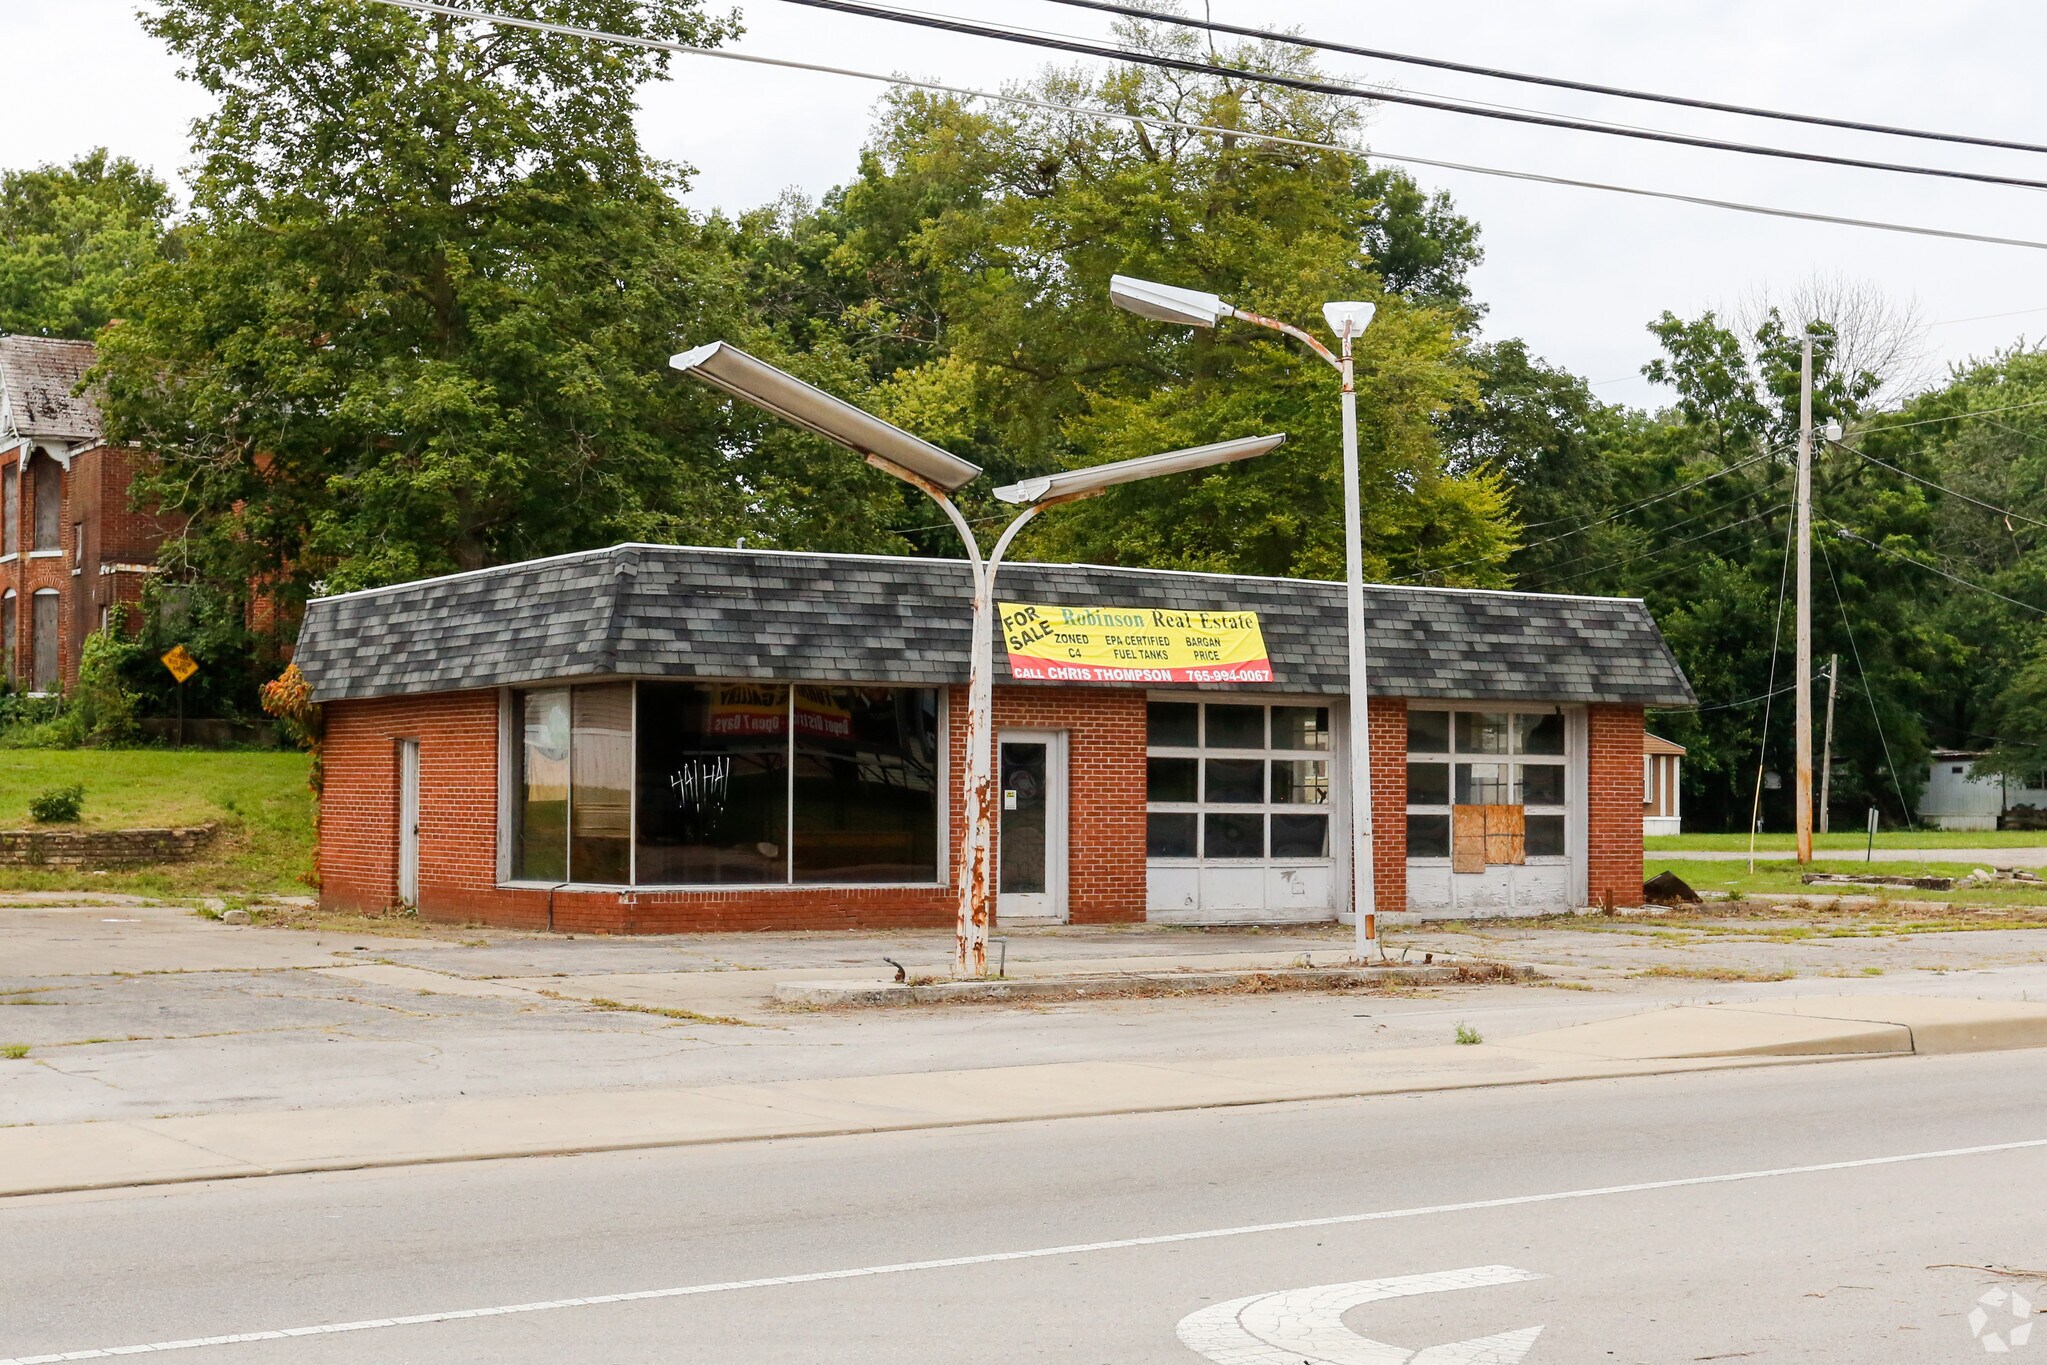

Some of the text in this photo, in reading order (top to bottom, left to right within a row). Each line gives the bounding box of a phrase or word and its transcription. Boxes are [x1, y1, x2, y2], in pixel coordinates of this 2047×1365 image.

[1003, 606, 1040, 632] FOR
[1060, 608, 1254, 629] Robinson Real Estate
[1009, 620, 1054, 650] SALE
[1055, 633, 1089, 644] ZONED
[1105, 635, 1170, 646] EPA CERTIFIED
[1185, 636, 1221, 647] BARGAN
[1068, 647, 1082, 658] C4
[1113, 649, 1169, 660] FUEL TANKS
[1193, 650, 1221, 661] PRICE
[1014, 667, 1270, 682] CALL CHRIS THOMPSON 765-994-0067
